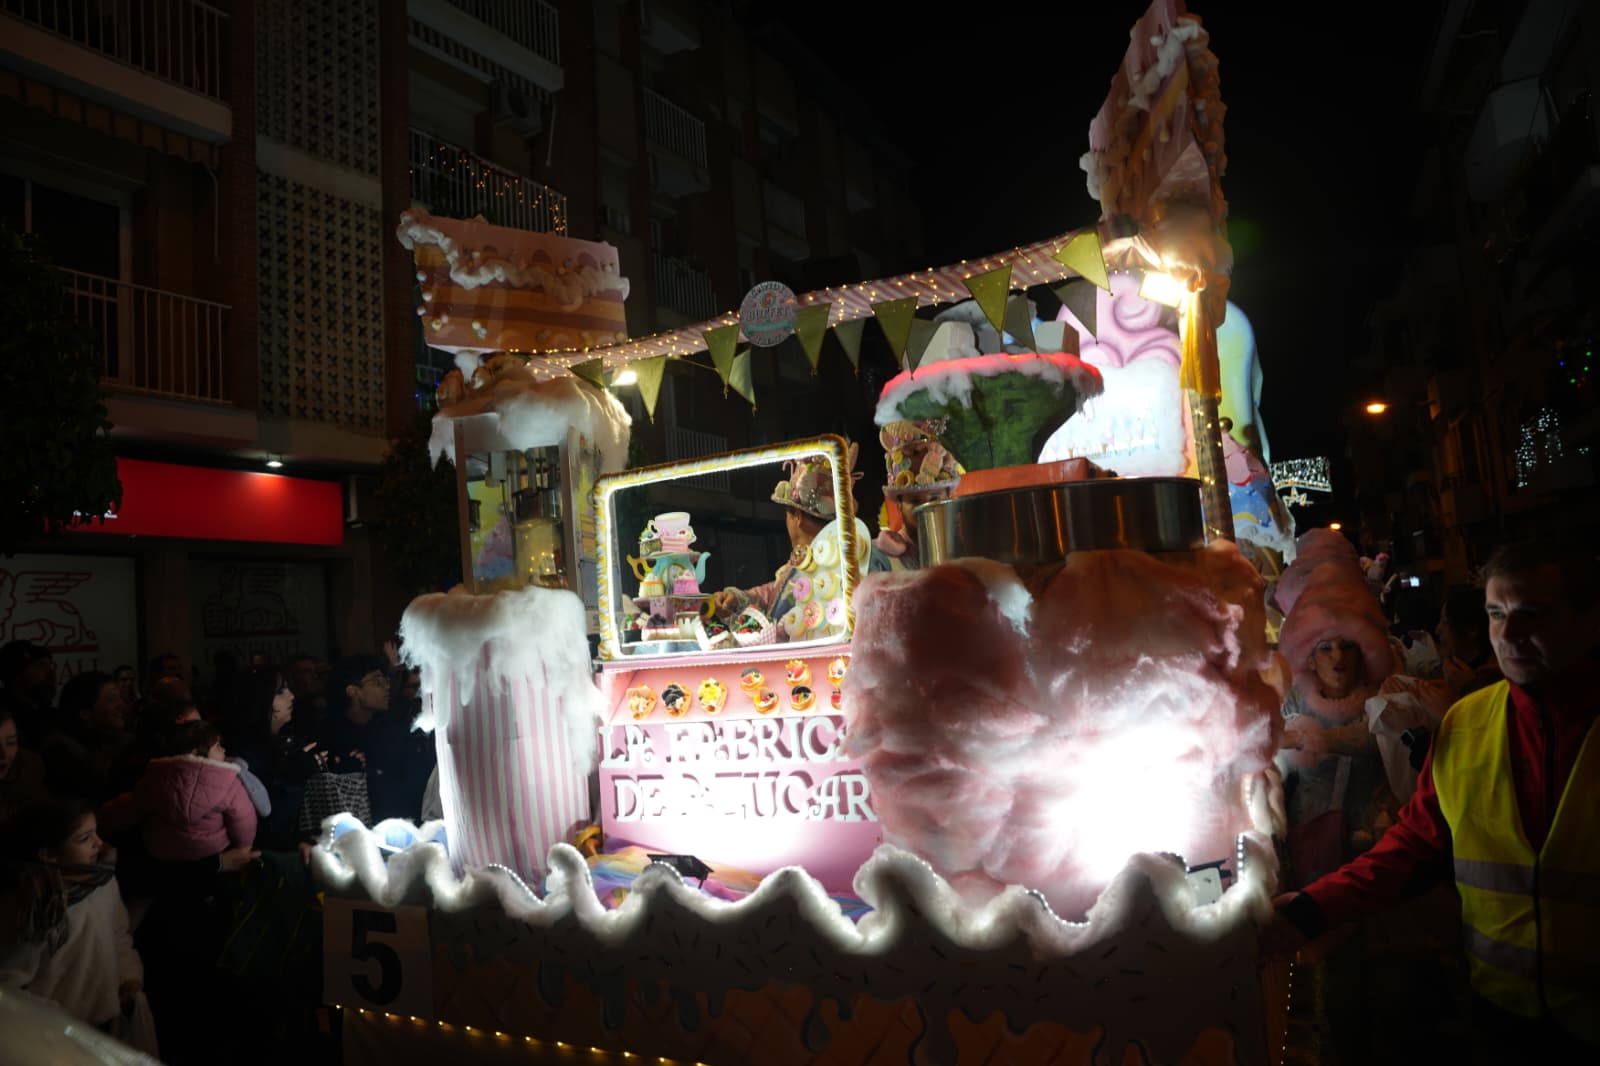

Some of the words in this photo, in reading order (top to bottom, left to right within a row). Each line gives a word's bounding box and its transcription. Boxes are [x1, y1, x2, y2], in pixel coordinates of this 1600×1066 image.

[599, 724, 657, 768] LA
[613, 776, 670, 822] DE
[351, 909, 402, 1005] 5
